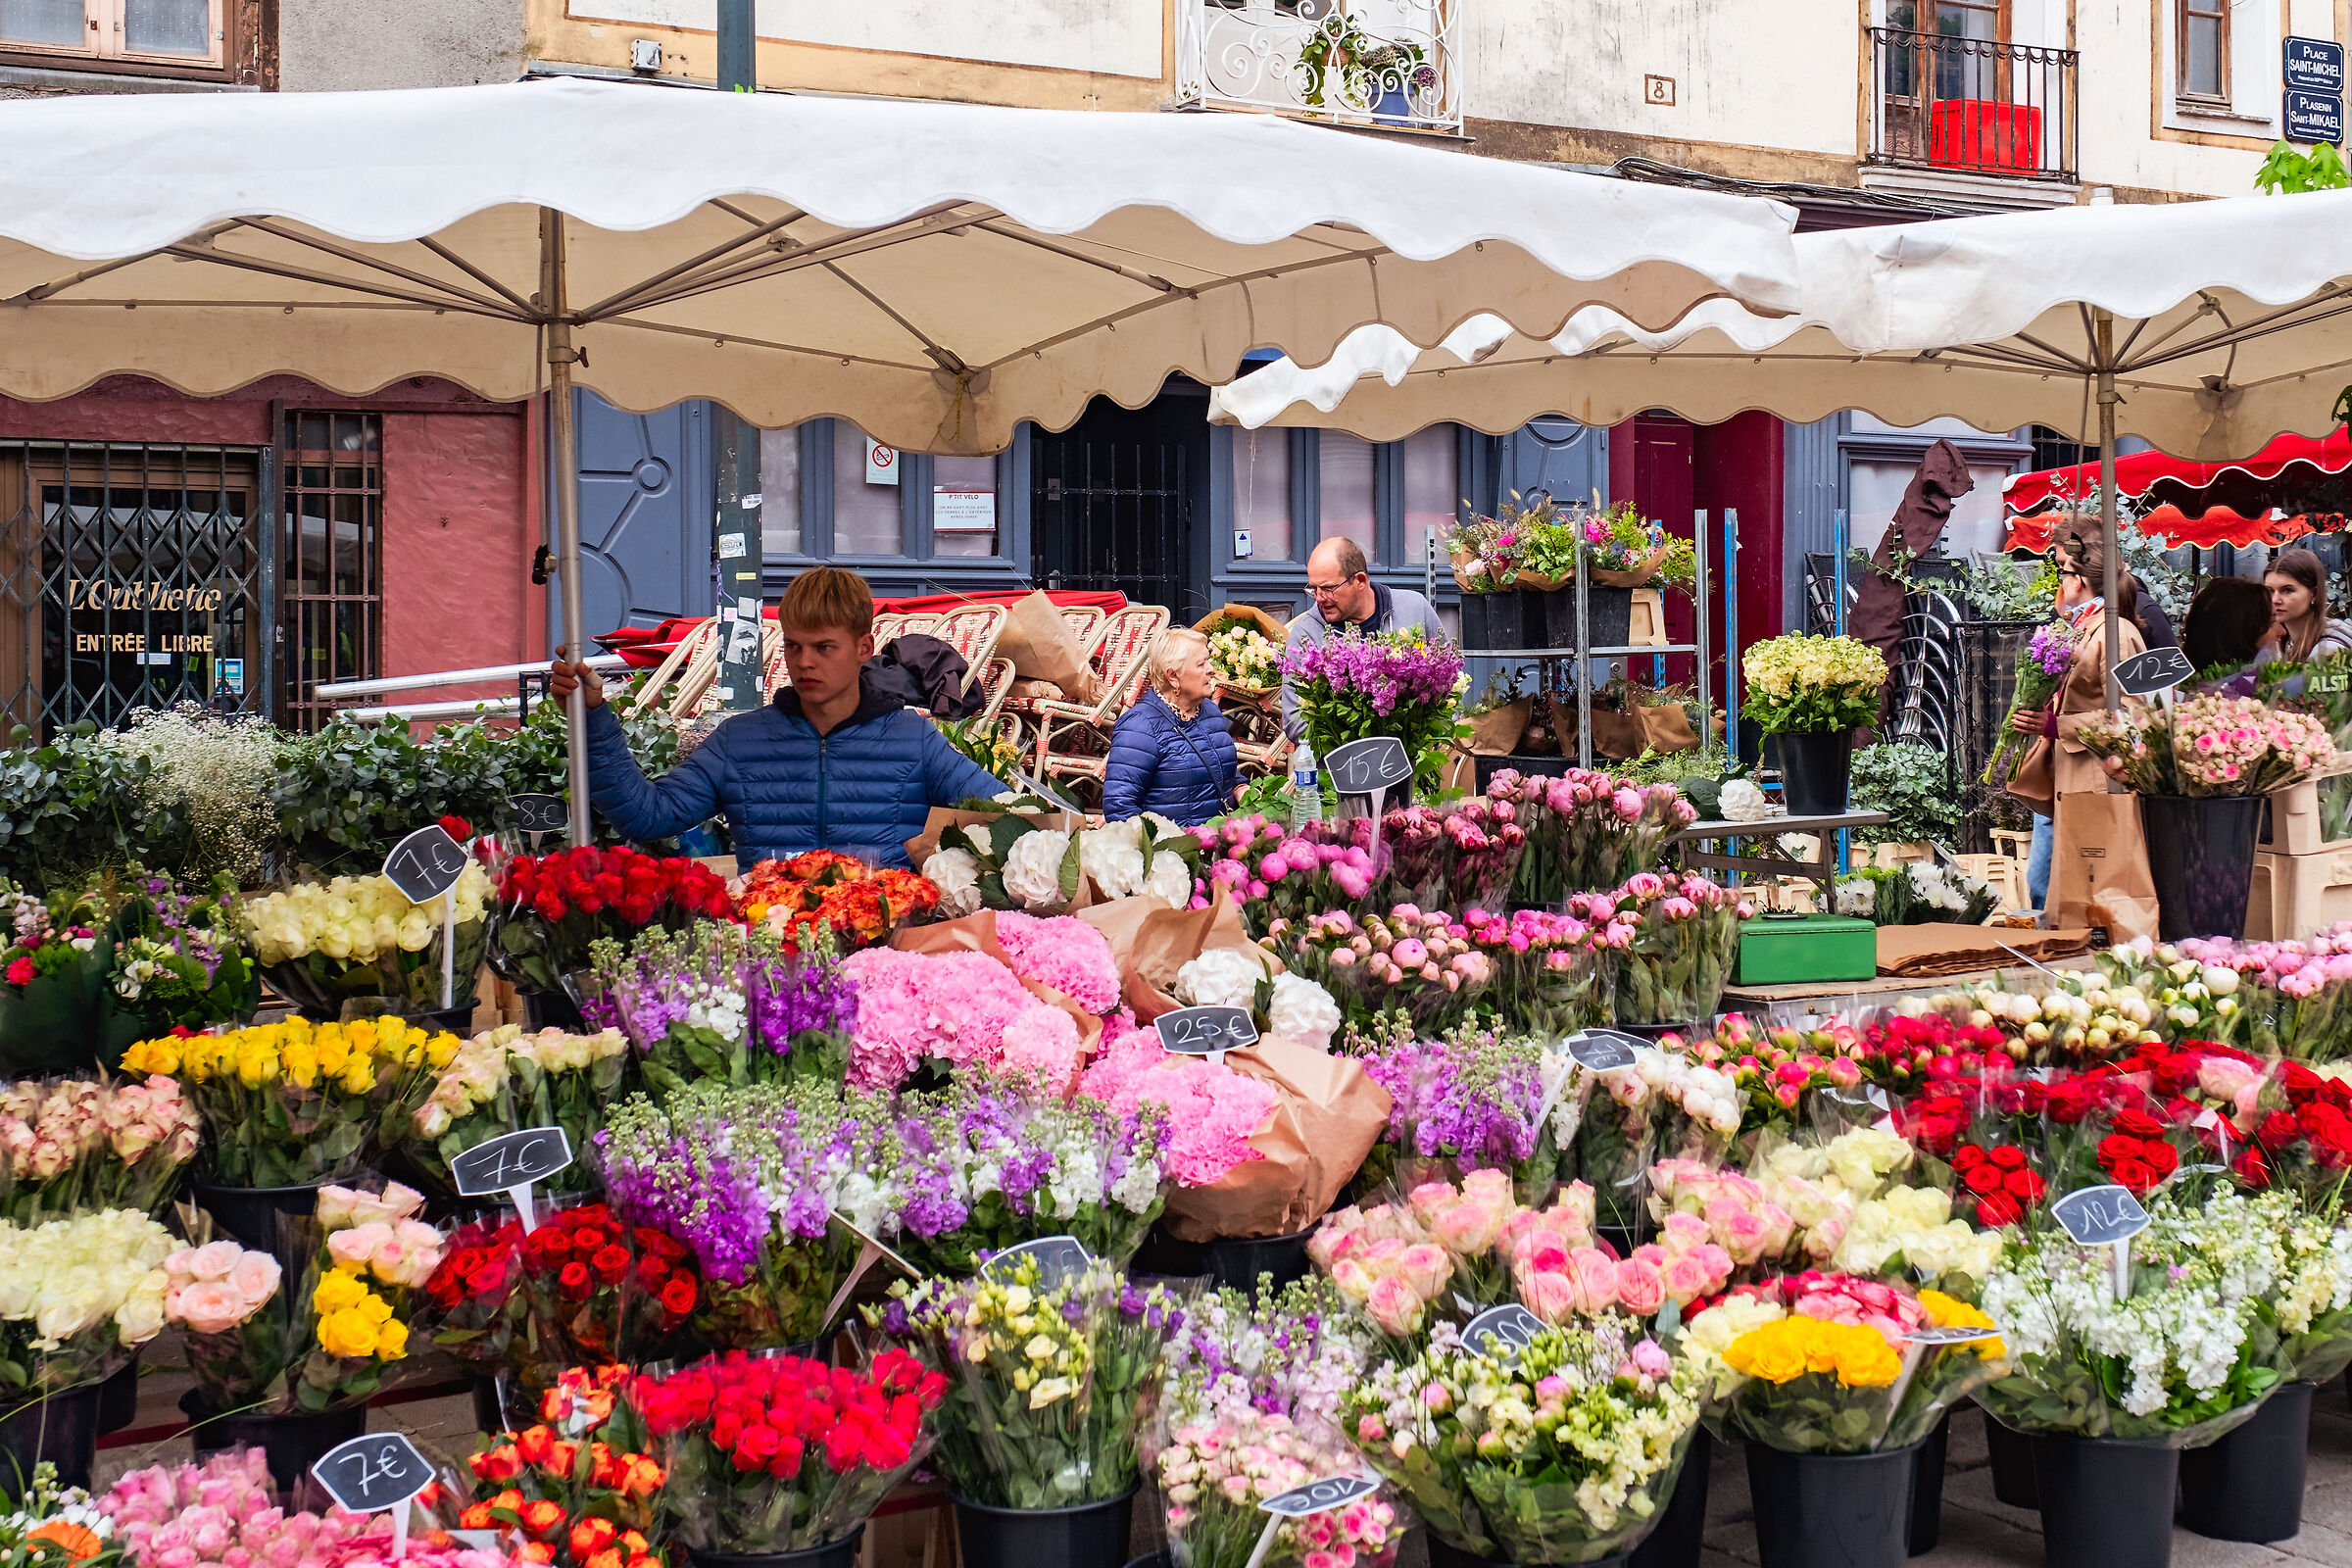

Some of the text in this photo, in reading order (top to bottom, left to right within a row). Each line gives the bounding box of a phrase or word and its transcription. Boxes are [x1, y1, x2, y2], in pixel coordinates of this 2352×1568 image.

[2303, 45, 2328, 61] PLACE
[2289, 59, 2341, 77] SAINT-MICHEL
[1653, 80, 1665, 100] 8
[2299, 96, 2332, 113] PLASENN
[2290, 110, 2341, 129] SANT-MIKAEL
[161, 634, 214, 653] LIBRE
[2125, 652, 2189, 681] 12€
[1336, 743, 1409, 785] 15€
[520, 800, 560, 826] 8€
[394, 842, 464, 890] 7€
[1174, 1015, 1254, 1045] 25€
[466, 1138, 551, 1185] 7€
[337, 1444, 408, 1497] 7€
